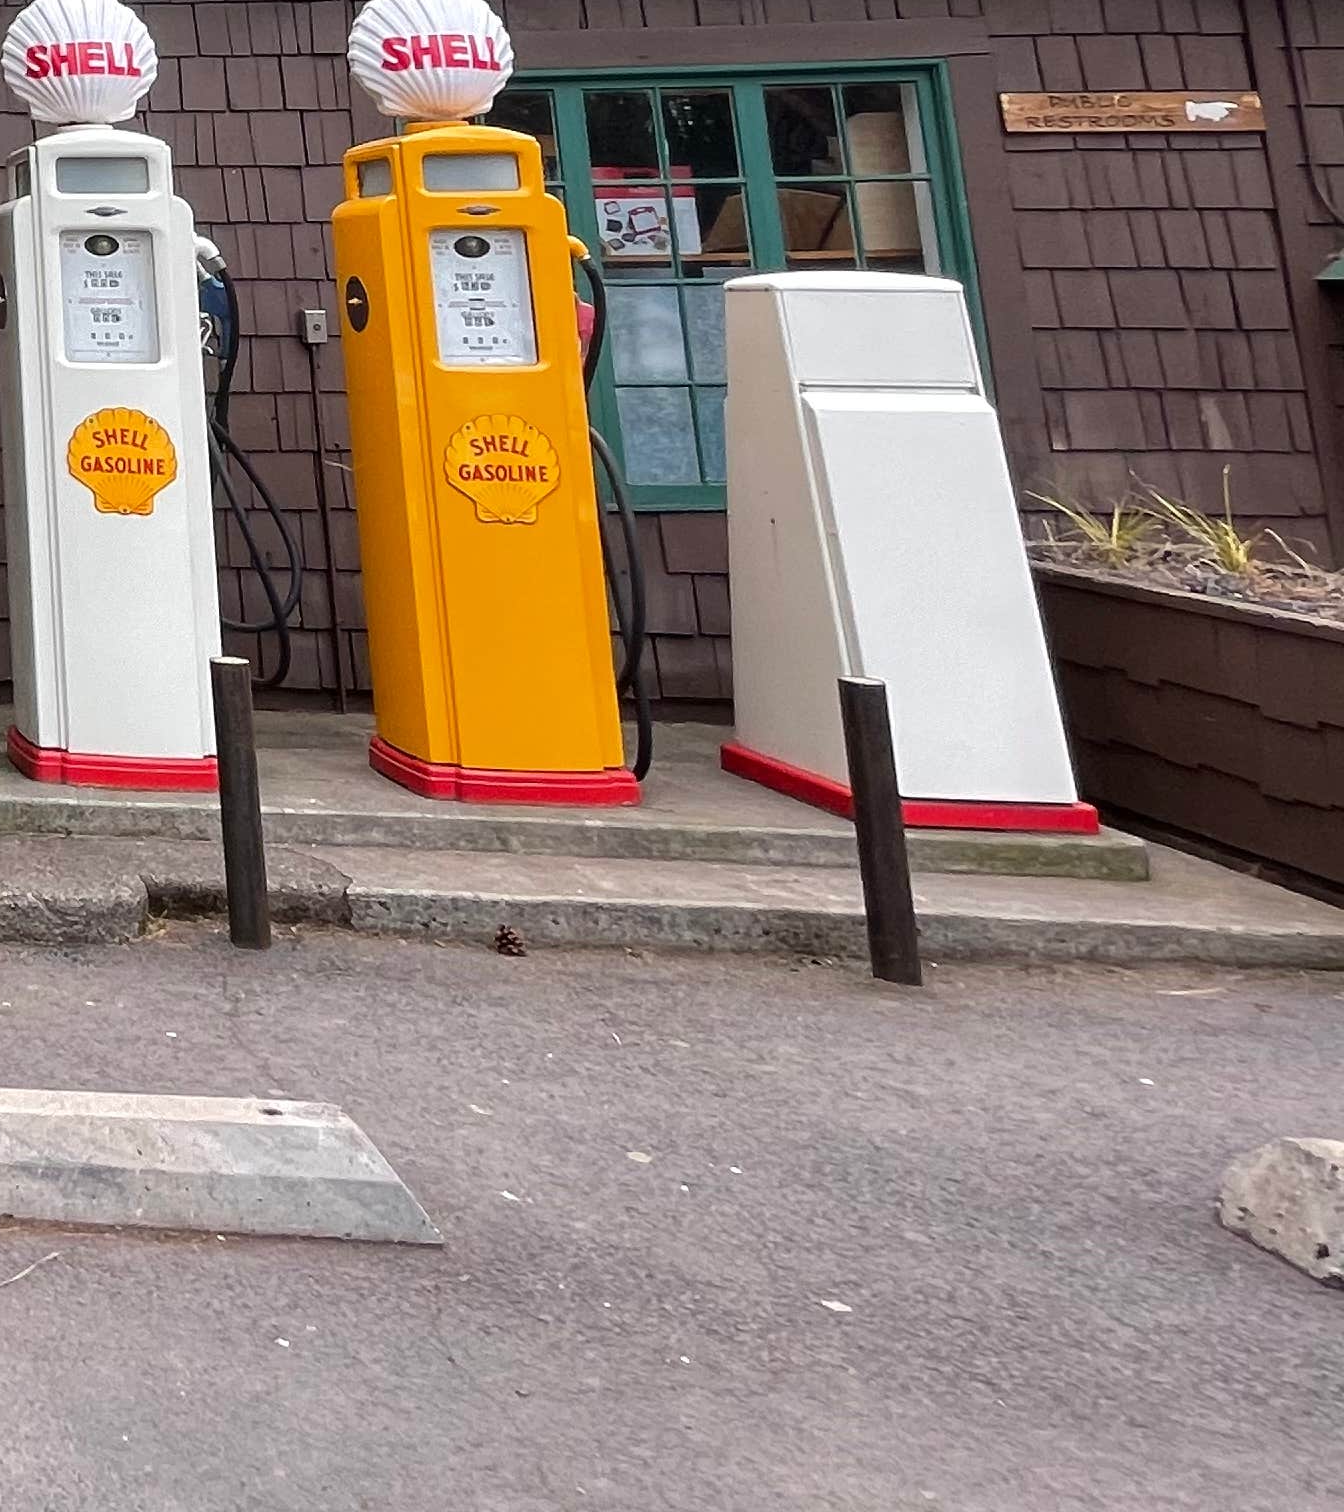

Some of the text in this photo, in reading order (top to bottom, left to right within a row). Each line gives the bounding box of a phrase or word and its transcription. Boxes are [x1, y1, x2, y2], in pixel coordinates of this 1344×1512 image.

[25, 42, 141, 79] SHELL
[381, 34, 501, 72] SHELL
[1025, 115, 1175, 128] RESTROOMS
[92, 428, 148, 450] SHELL
[469, 435, 528, 457] SHELL
[80, 456, 165, 475] GASOLINE
[458, 464, 548, 482] GASOLINE
